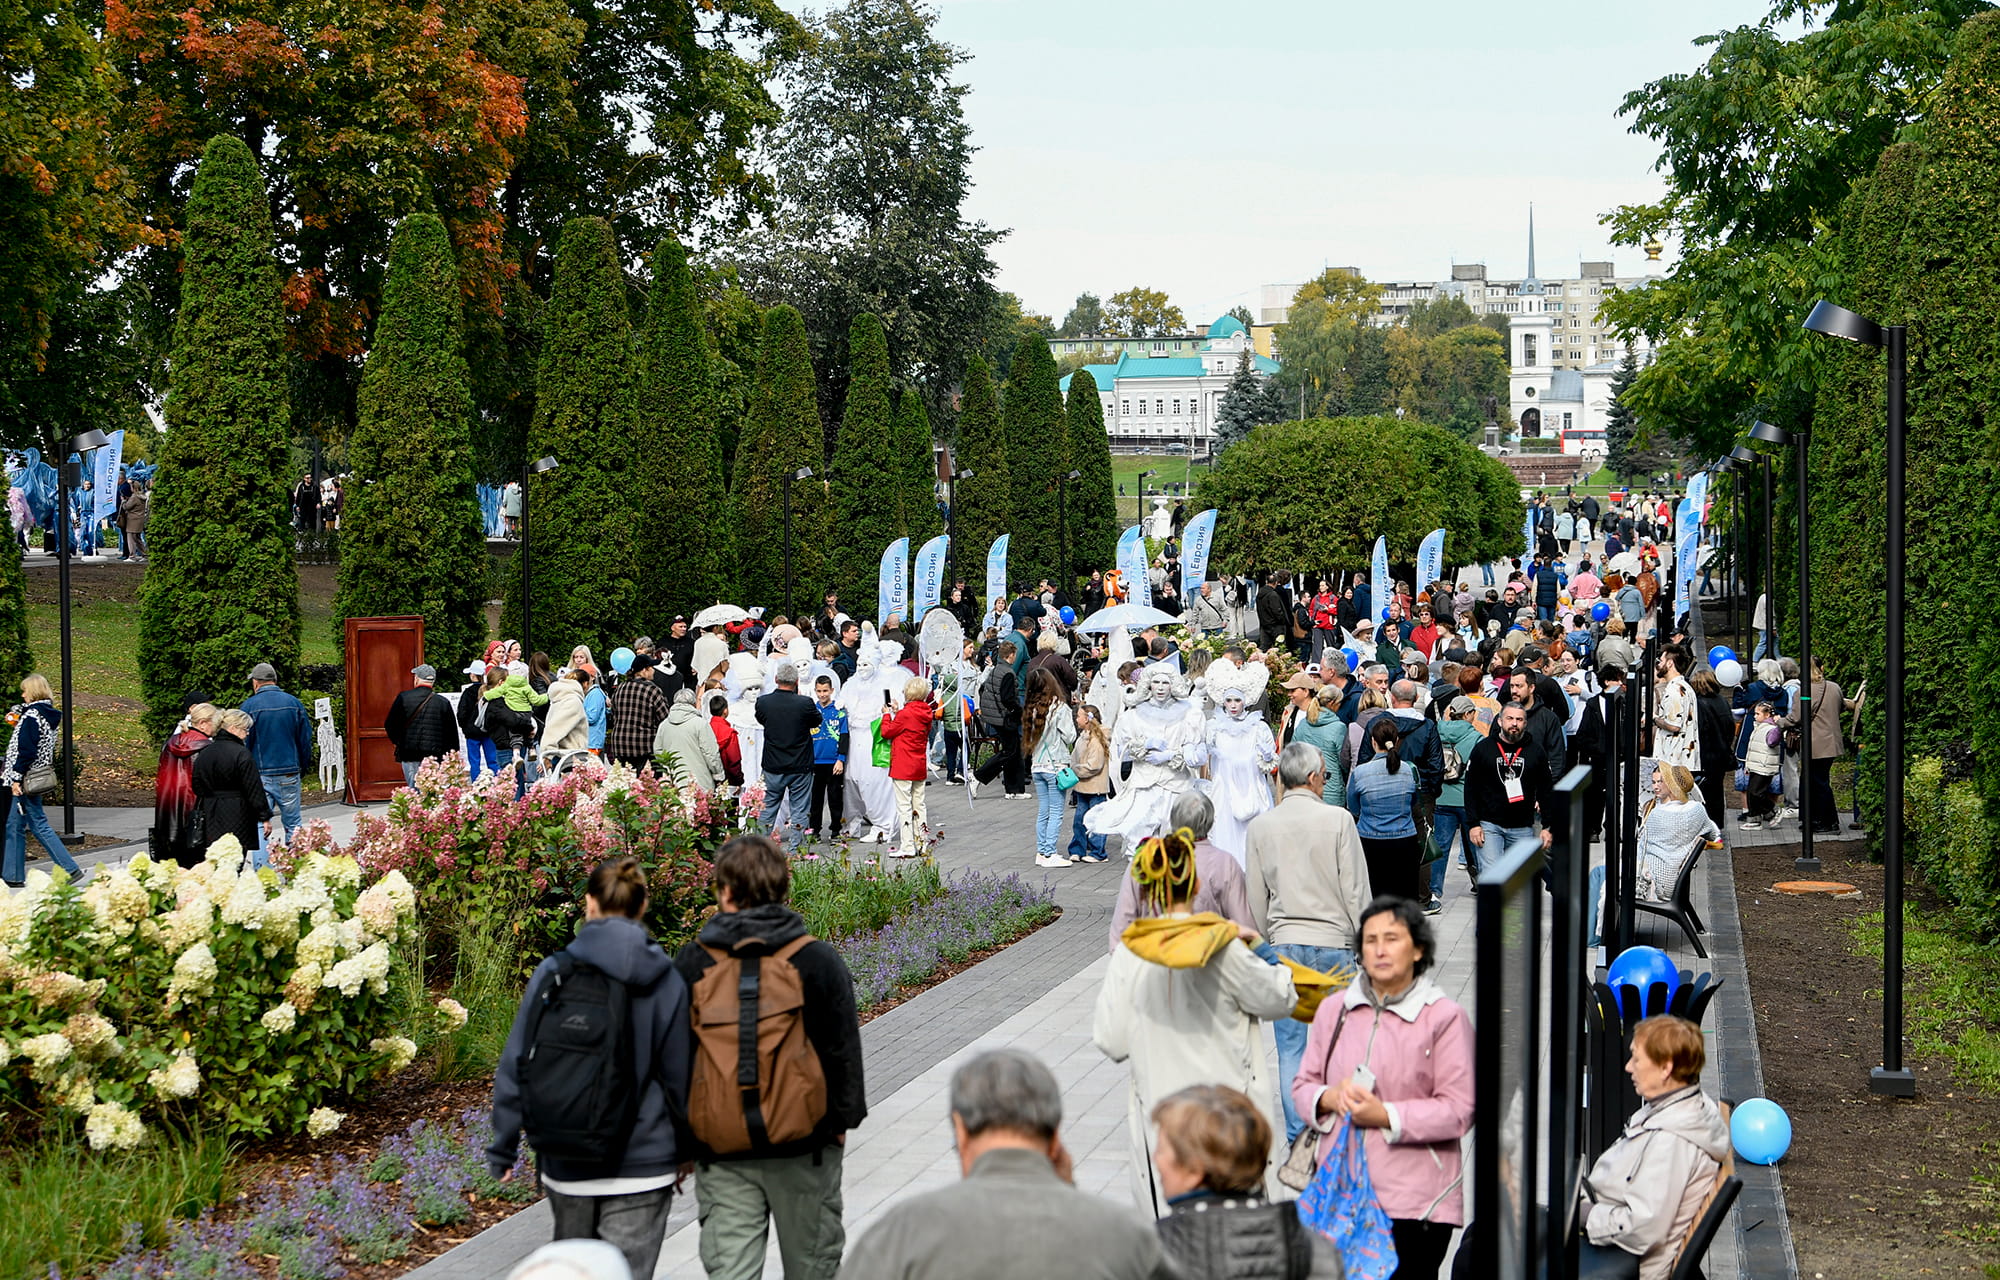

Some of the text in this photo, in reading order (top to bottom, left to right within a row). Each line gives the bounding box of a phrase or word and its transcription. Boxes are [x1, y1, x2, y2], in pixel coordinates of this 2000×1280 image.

[1190, 525, 1207, 570] Евразия
[891, 556, 904, 603] Евразия
[925, 553, 937, 598] Евразия
[1139, 556, 1151, 606] Евразия
